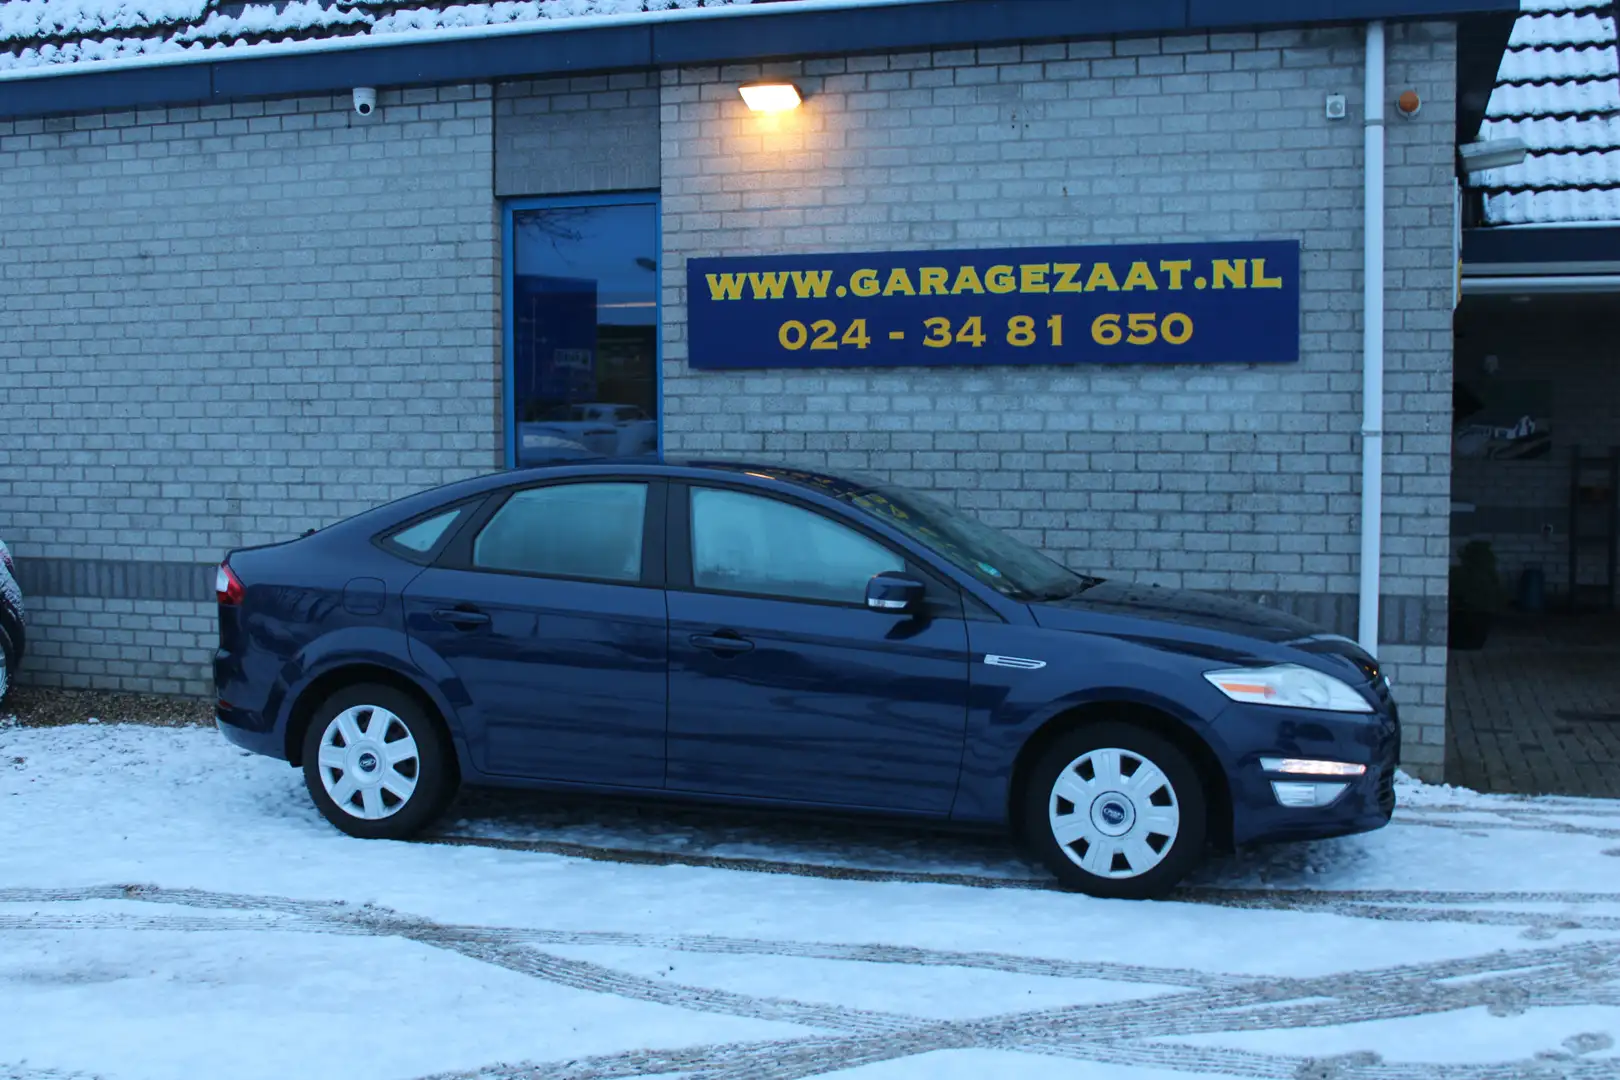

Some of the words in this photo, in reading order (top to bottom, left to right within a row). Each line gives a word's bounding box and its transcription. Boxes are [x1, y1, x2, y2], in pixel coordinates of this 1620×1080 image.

[705, 258, 1283, 301] WWW.GARAGEZAAT.NL
[778, 319, 871, 350] 024
[923, 316, 987, 348] 34
[1006, 314, 1062, 347] 81
[1091, 312, 1194, 345] 650
